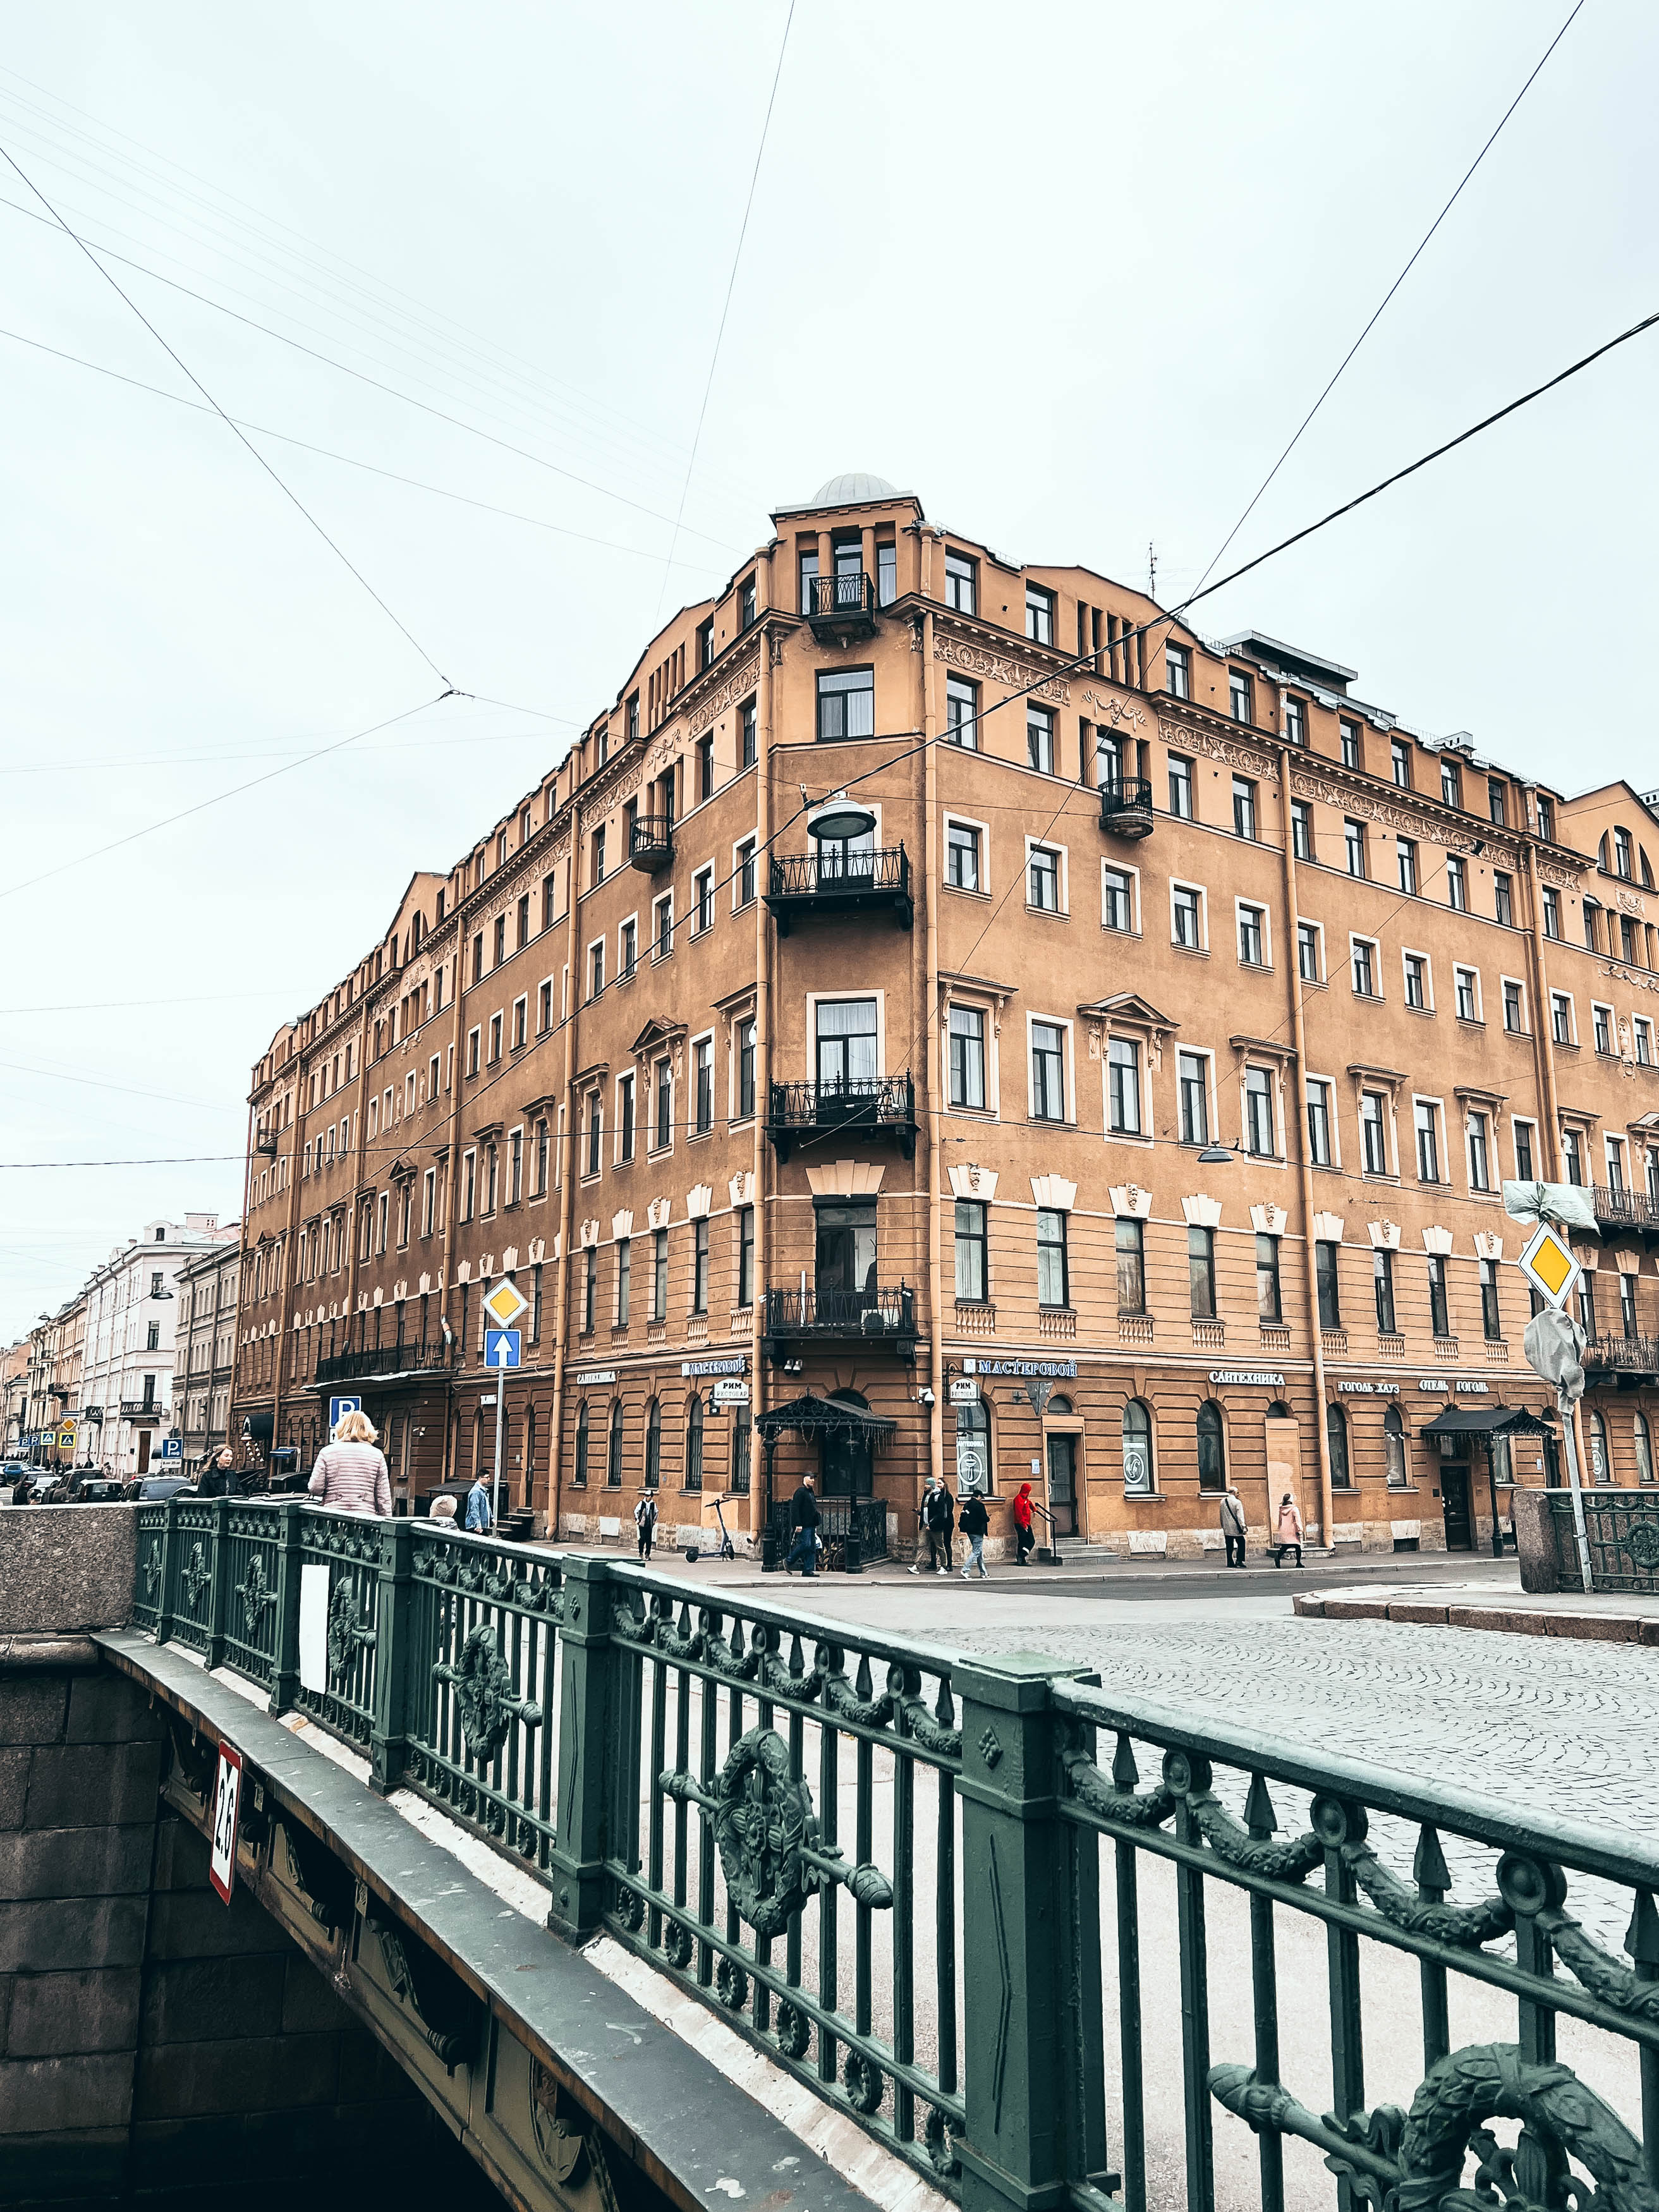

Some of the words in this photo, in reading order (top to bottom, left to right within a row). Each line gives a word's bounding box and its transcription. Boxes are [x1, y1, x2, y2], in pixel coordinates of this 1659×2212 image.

[689, 1354, 745, 1375] МАСТЕРОВОЙ
[978, 1359, 1078, 1376] МАСТЕРОВОЙ
[1208, 1370, 1285, 1385] САНТЕХНИКА
[1338, 1382, 1374, 1392] ГОГОЛЬ
[1375, 1383, 1400, 1394] ХАУЗ
[1419, 1380, 1449, 1391] ОТЕЛЬ
[1456, 1381, 1489, 1393] ГОГОЛЬ
[167, 1440, 179, 1456] P
